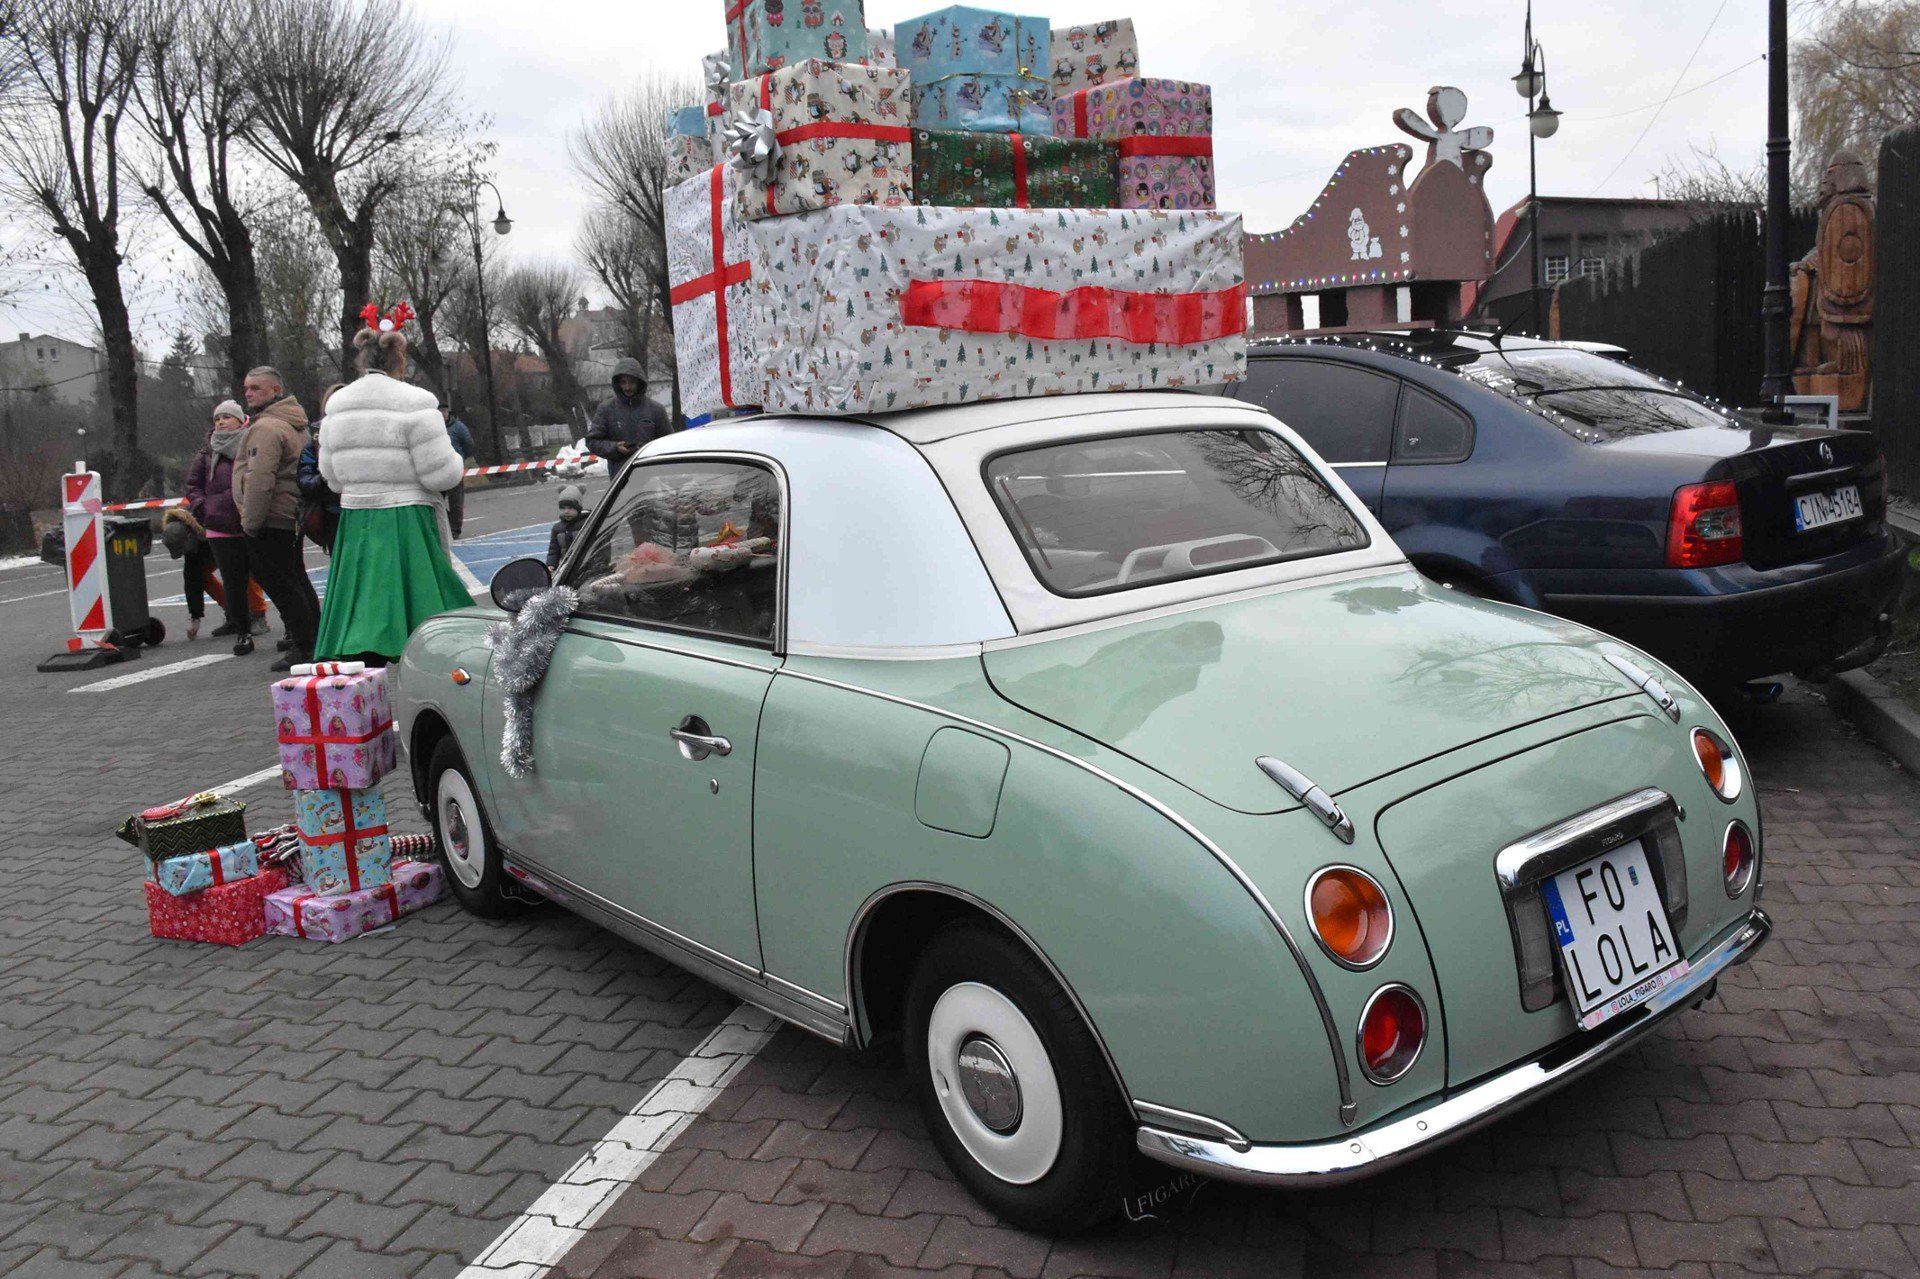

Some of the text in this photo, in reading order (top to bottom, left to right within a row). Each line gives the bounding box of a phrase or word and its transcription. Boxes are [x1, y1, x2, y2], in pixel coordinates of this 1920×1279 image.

[1800, 489, 1861, 525] CIN 45184
[1575, 860, 1626, 926] FO
[1555, 921, 1570, 937] PL
[1570, 910, 1672, 1002] LOLA
